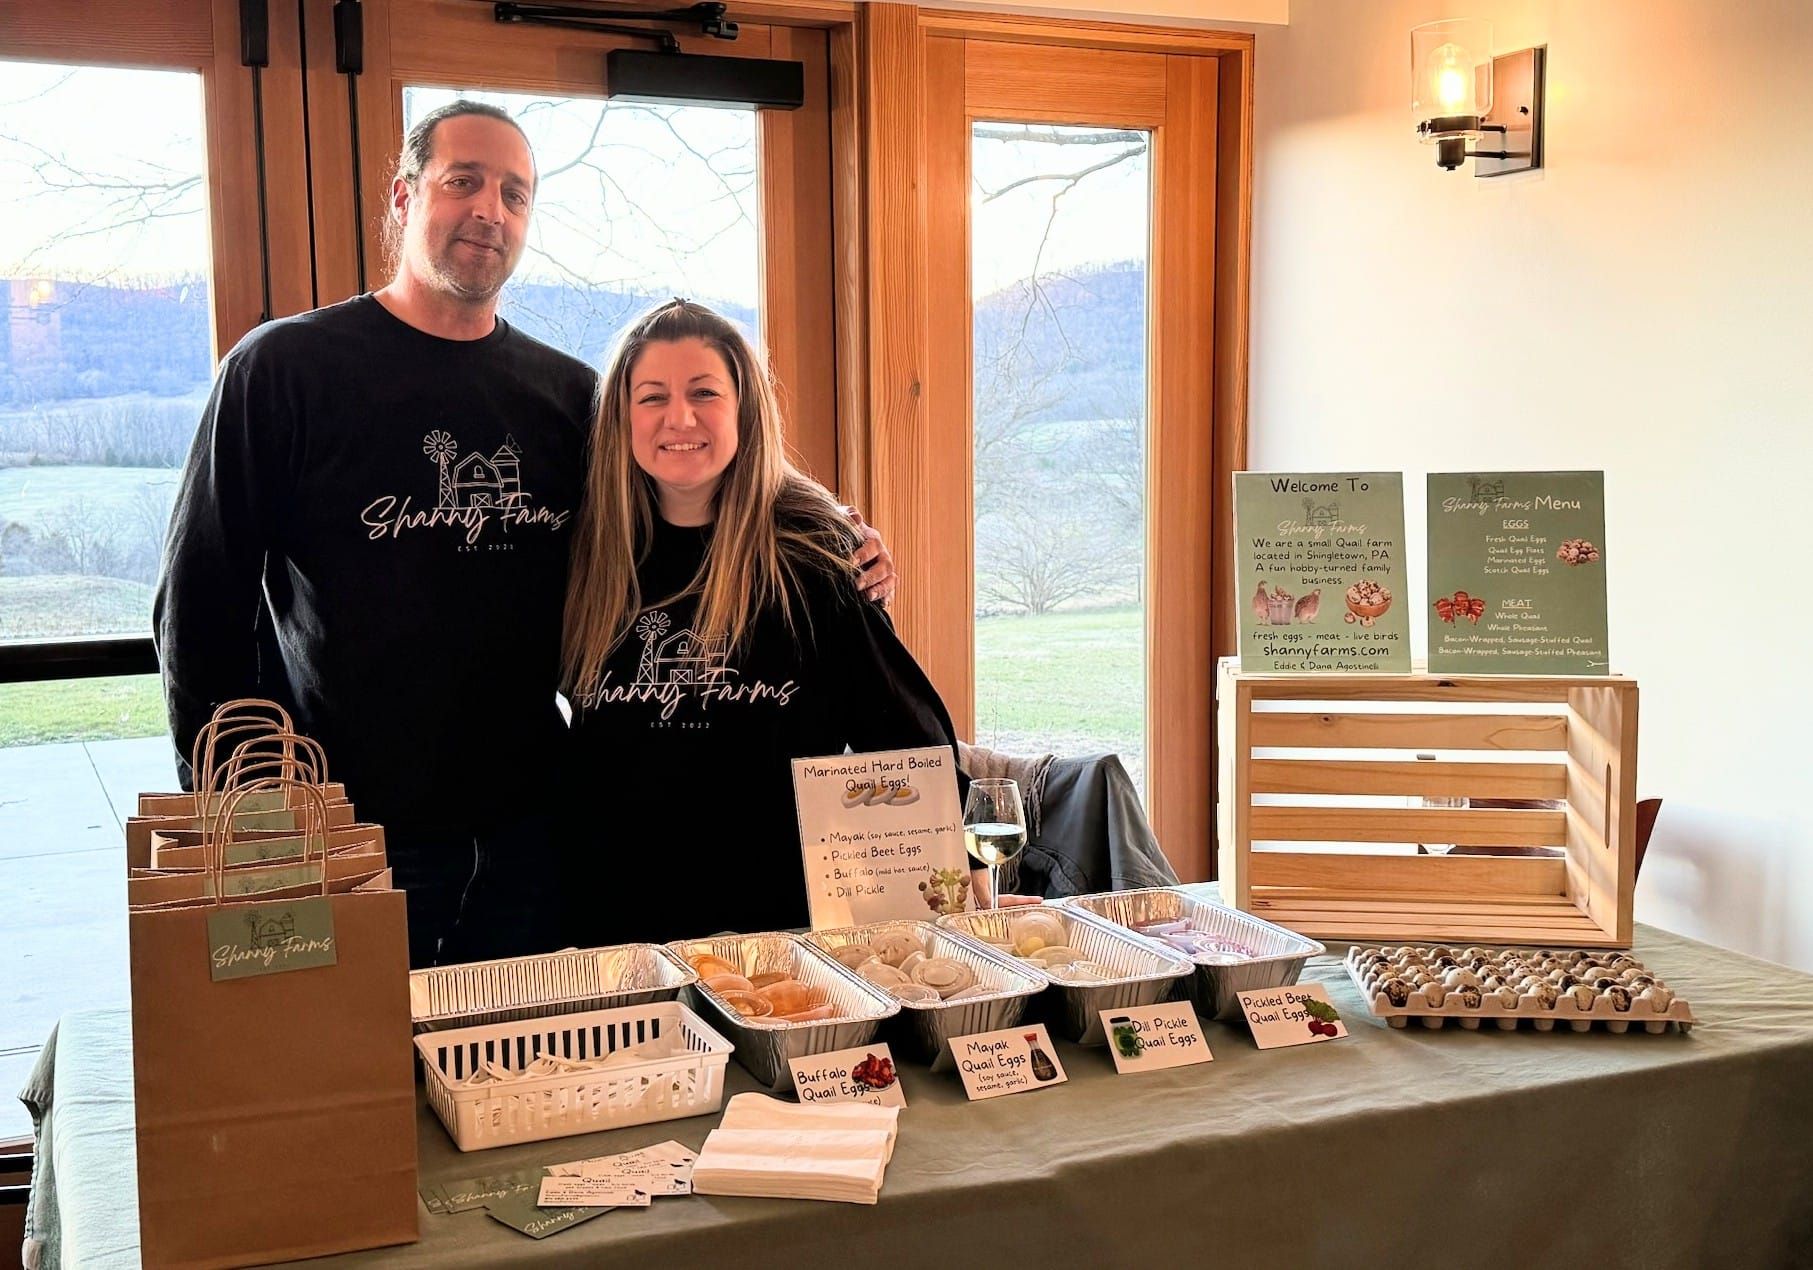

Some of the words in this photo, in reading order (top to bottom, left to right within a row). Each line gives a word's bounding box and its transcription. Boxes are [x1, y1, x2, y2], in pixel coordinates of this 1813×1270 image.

[1270, 478, 1339, 493] Welcome
[1346, 478, 1369, 492] To
[1493, 497, 1532, 512] Farms
[1534, 495, 1581, 510] Menu
[361, 496, 490, 544] Shanny
[1503, 519, 1529, 528] EGGS
[1253, 538, 1271, 548] We
[1308, 539, 1331, 548] small
[1336, 538, 1362, 548] Quail
[1367, 538, 1392, 548] farm
[1486, 535, 1506, 543] Fresh
[1509, 535, 1528, 544] Quail
[1530, 535, 1547, 544] Eggs
[1254, 551, 1290, 560] located
[1295, 552, 1302, 560] in
[1307, 550, 1367, 562] Shingletown,
[1488, 546, 1508, 554] Quail
[1510, 546, 1523, 555] Egg
[1487, 556, 1526, 564] Marinated
[1528, 557, 1546, 565] Eggs
[1256, 563, 1264, 572] A
[1269, 564, 1286, 572] fun
[1290, 563, 1357, 574] hobby-turned
[1362, 563, 1391, 574] family
[1484, 566, 1509, 574] Scotch
[1511, 566, 1530, 574] Quail
[1532, 566, 1549, 575] Eggs
[1502, 599, 1532, 608] MEAT
[1495, 612, 1518, 620] Whole
[1520, 612, 1541, 620] Quail
[1487, 624, 1511, 632] Whole
[1253, 632, 1278, 640] fresh
[1283, 633, 1303, 643] eggs
[1353, 632, 1370, 640] live
[1373, 632, 1399, 641] birds
[1572, 636, 1593, 644] Quail
[1263, 642, 1389, 659] shannyfarms.com
[1274, 661, 1297, 670] Eddie
[1309, 661, 1332, 670] Dana
[697, 668, 800, 710] Farms
[804, 761, 867, 778] Marinated
[871, 759, 904, 773] Hard
[908, 756, 942, 770] Boiled
[845, 779, 876, 793] Quail
[881, 774, 910, 792] Eggs!
[829, 831, 865, 845] Mayak
[831, 848, 867, 861] Pickled
[871, 847, 895, 858] Beet
[899, 843, 922, 857] Eggs
[834, 867, 874, 880] Buffalo
[836, 886, 852, 898] Dill
[856, 884, 885, 896] Pickle
[213, 945, 277, 968] Shanny
[281, 936, 335, 958] Farms
[1242, 995, 1283, 1009] Pickled
[1285, 992, 1312, 1004] Beet
[1249, 1011, 1280, 1025] Quail
[1282, 1008, 1310, 1023] Eggs
[1132, 1020, 1151, 1033] Dill
[1154, 1017, 1189, 1031] Pickle
[967, 1040, 1009, 1055] Mayak
[1135, 1036, 1166, 1050] Quail
[1168, 1032, 1197, 1047] Eggs
[962, 1058, 995, 1074] Quail
[997, 1053, 1026, 1069] Eggs
[796, 1067, 847, 1084] Buffalo
[978, 1074, 994, 1083] (soy
[996, 1070, 1019, 1078] sauce,
[976, 1082, 1004, 1092] sesame,
[1005, 1075, 1028, 1088] garlic)
[802, 1085, 837, 1102] Quail
[840, 1081, 871, 1097] Eggs
